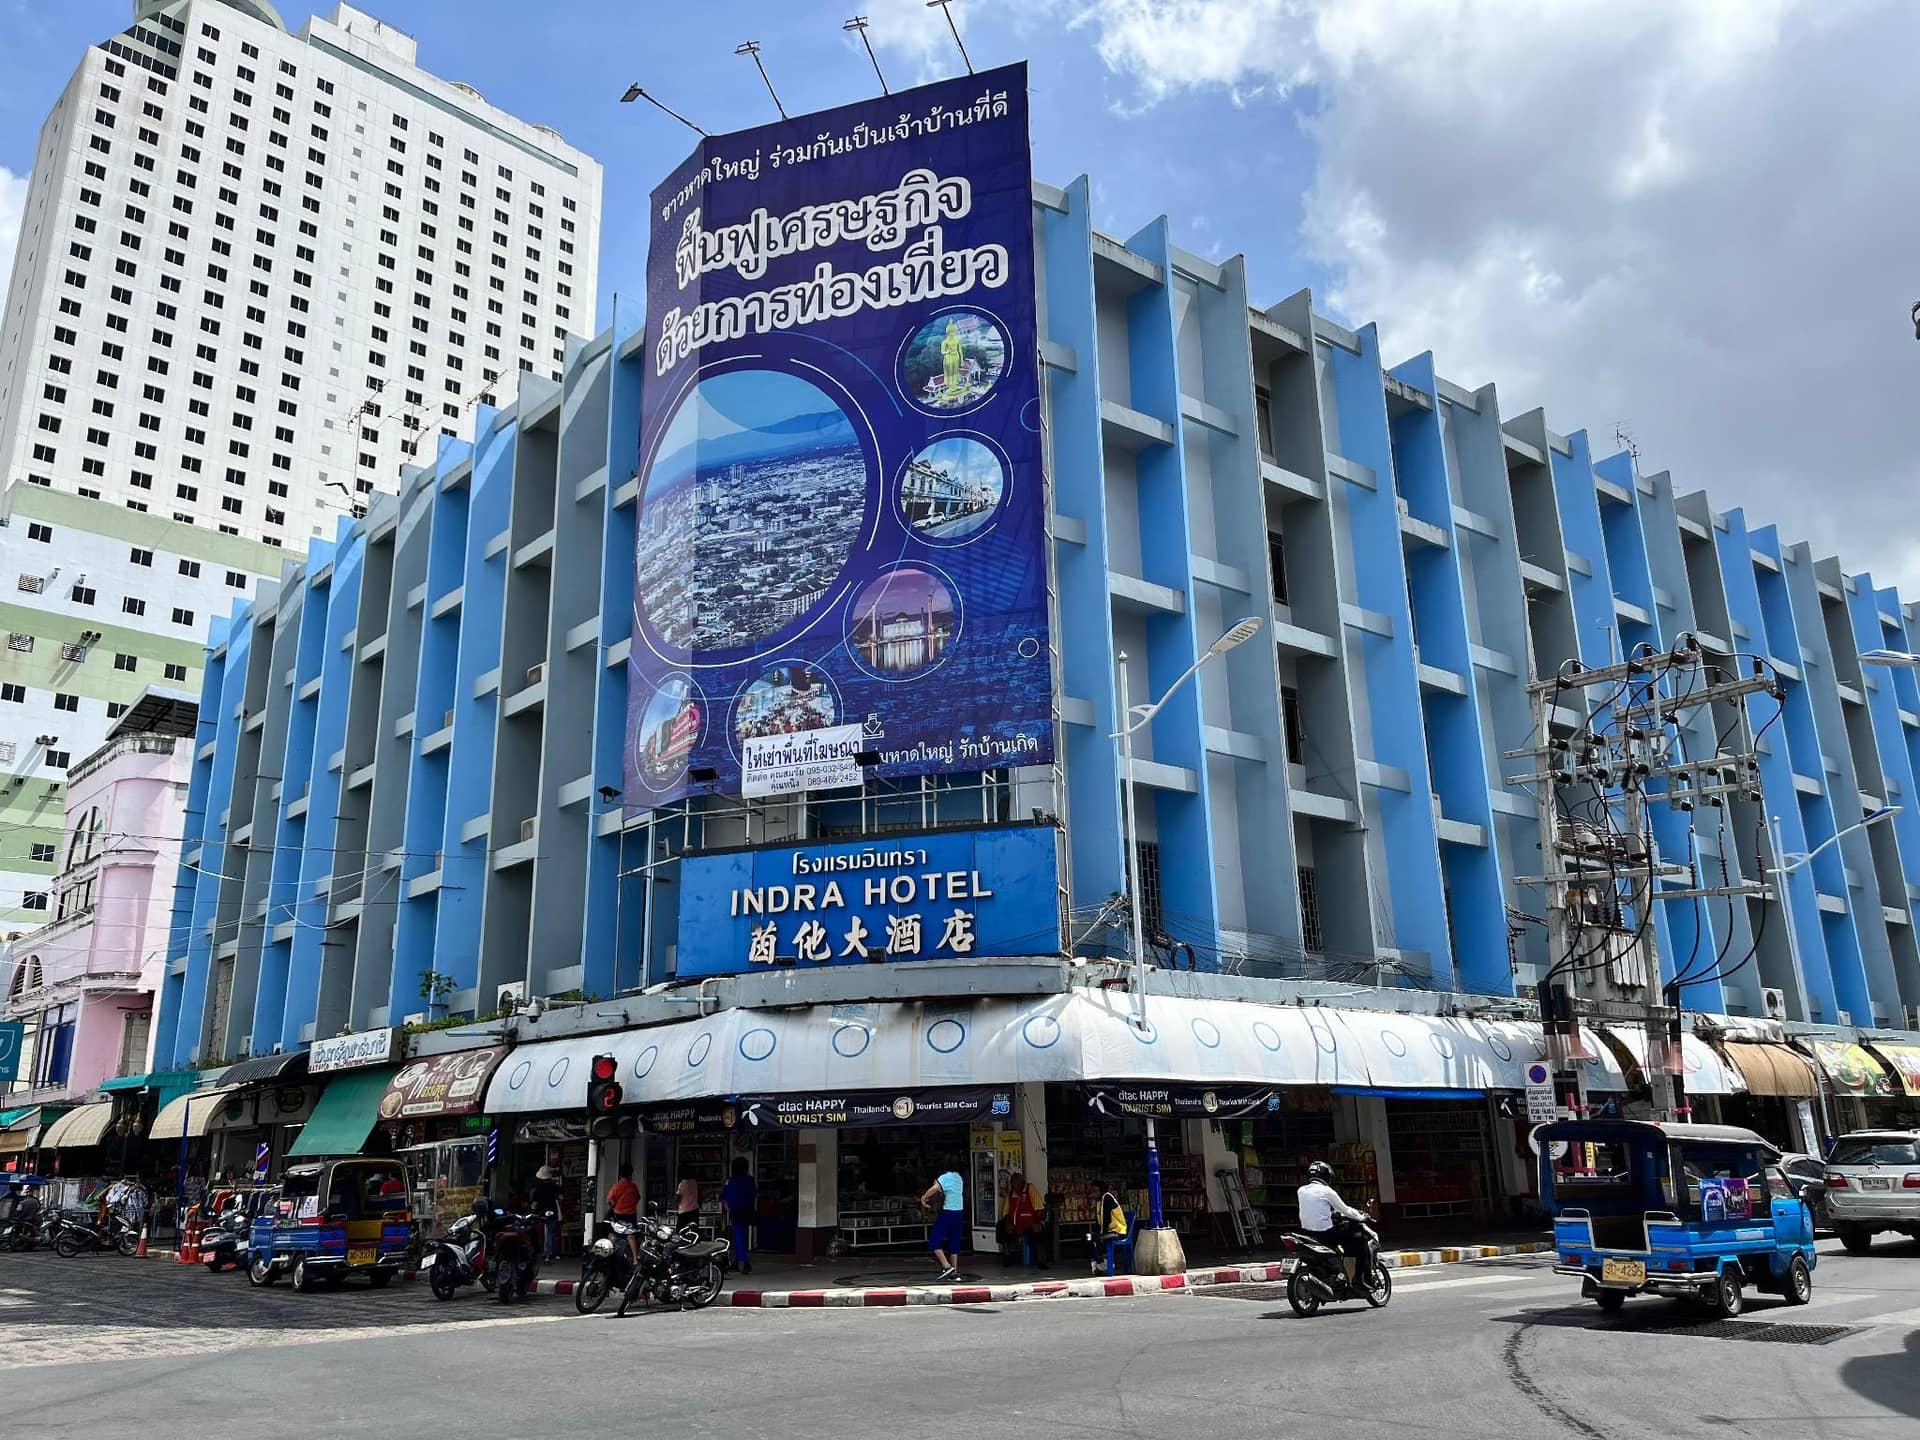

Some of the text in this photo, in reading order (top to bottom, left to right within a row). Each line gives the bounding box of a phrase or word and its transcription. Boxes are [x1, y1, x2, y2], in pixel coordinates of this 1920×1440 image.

[662, 89, 1009, 221] ชาวหาดใหญ่ ร่วมกันเป็นเจ้าบ้านที่ดี
[676, 169, 971, 289] ฟื้นฟูเศรษฐกิจ
[656, 227, 1009, 376] ด้วยการท่องเที่ยว
[746, 733, 860, 769] ให้เช่าพื้นที่โฆษณา
[959, 733, 1038, 758] รักบ้านเกิด
[792, 848, 928, 876] โรงแรมอินทรา
[731, 871, 993, 917] INDRA HOTEL
[777, 1098, 846, 1112] dtac HAPPY
[853, 1104, 892, 1114] Thailand's
[915, 1102, 942, 1110] Tourist
[959, 1100, 978, 1109] Card
[1118, 1089, 1169, 1101] dtac HAPPY
[1120, 1103, 1172, 1113] TOURIST SIM
[778, 1112, 846, 1124] TOURIST SIM
